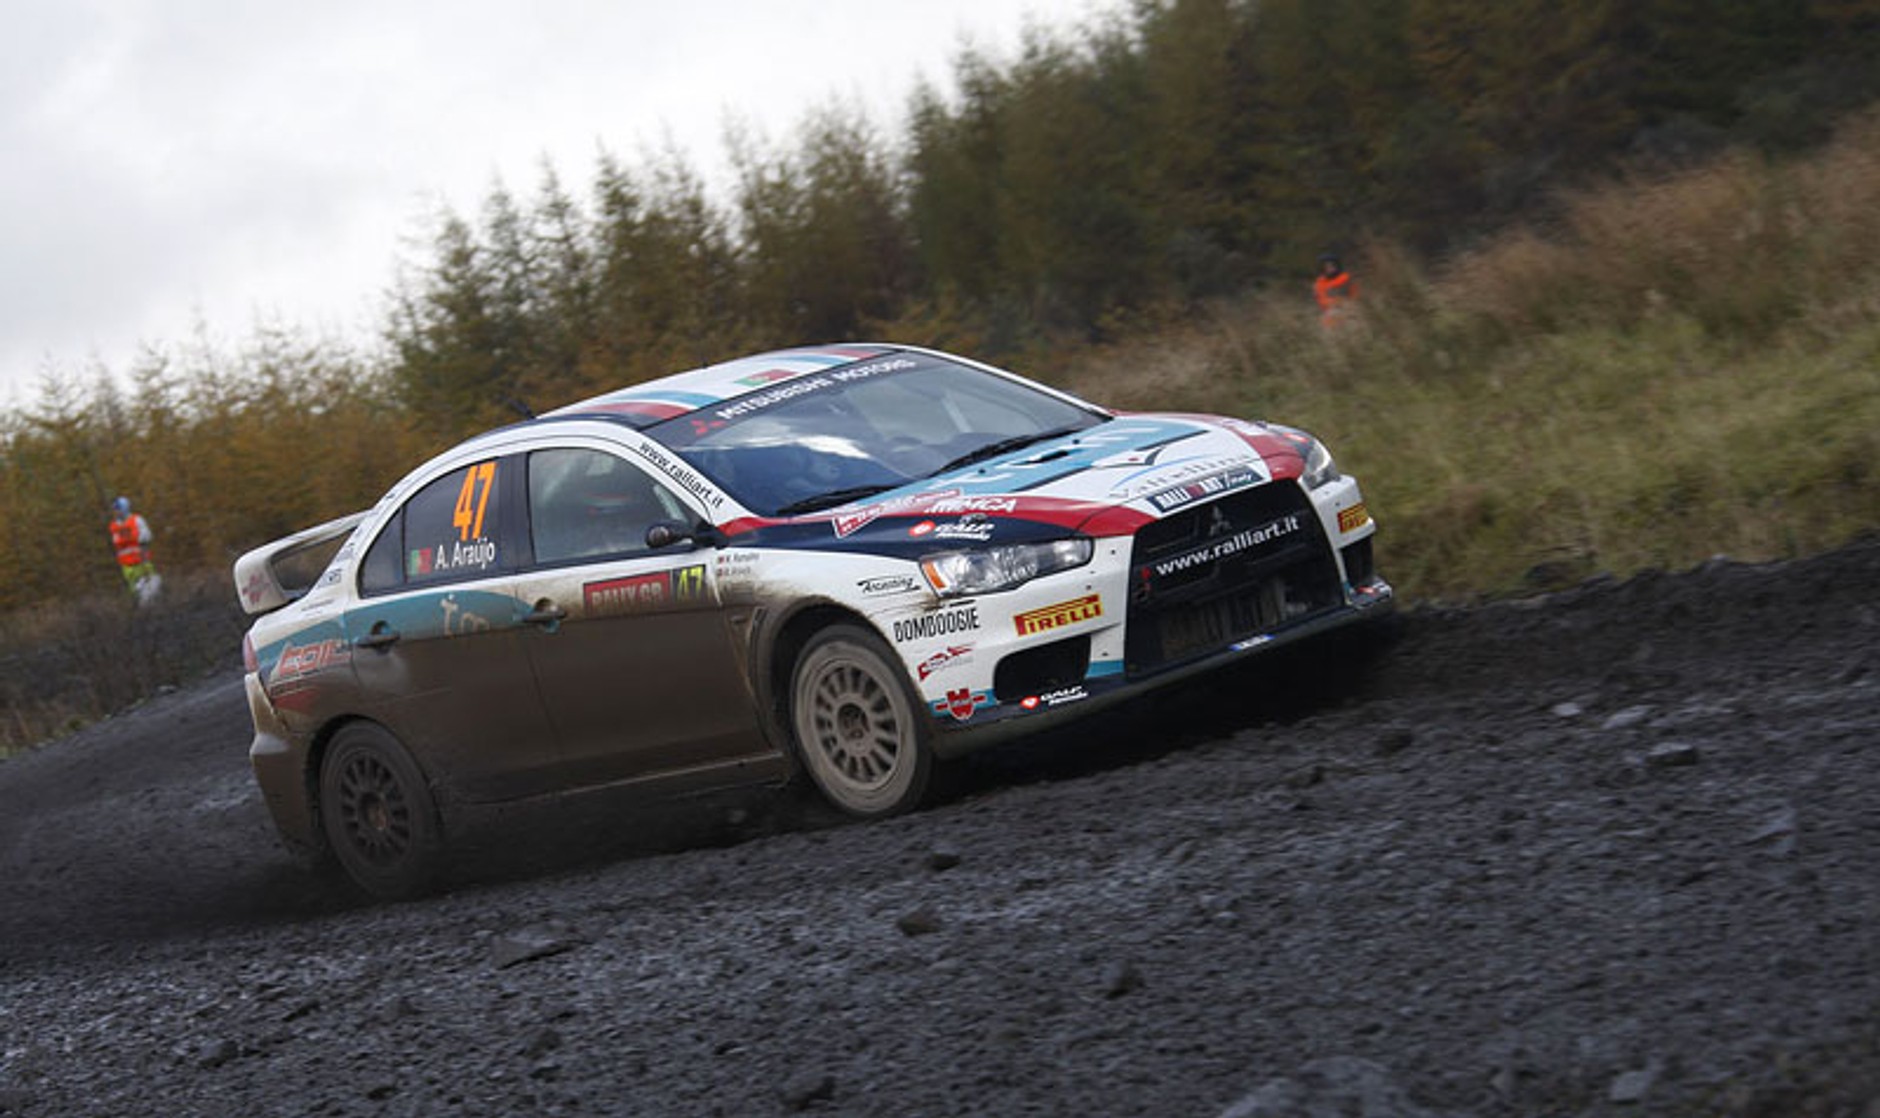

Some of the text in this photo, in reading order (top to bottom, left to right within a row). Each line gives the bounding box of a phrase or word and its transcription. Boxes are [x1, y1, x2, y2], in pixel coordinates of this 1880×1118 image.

[640, 442, 724, 508] www.ralliart.it
[453, 461, 497, 541] 47
[435, 544, 449, 570] A.
[1156, 515, 1301, 577] www.ralliart.it
[677, 565, 704, 601] 47
[893, 607, 980, 642] BOMBOOGIE
[1014, 594, 1102, 637] PIRELLI
